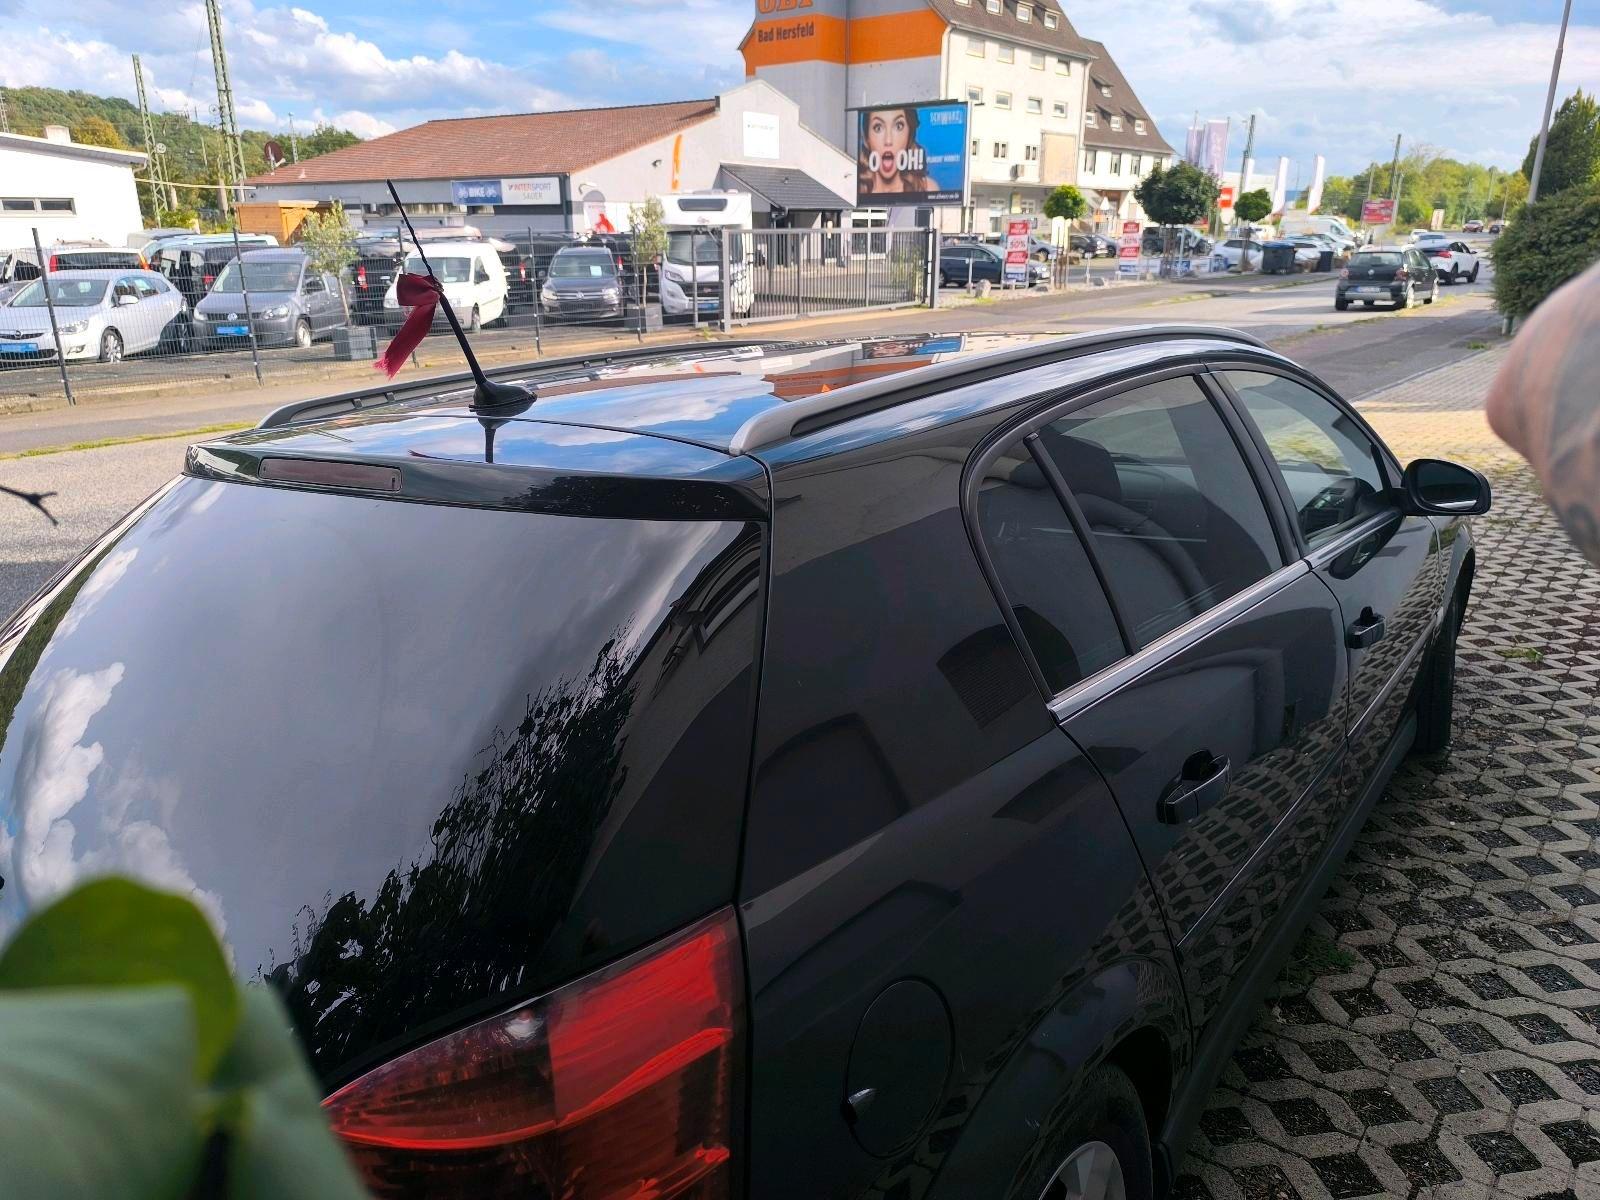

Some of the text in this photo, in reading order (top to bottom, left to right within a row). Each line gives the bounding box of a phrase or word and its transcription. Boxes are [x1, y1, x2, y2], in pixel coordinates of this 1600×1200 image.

[758, 21, 815, 42] Bad Hersfeld
[468, 187, 484, 197] BIKE
